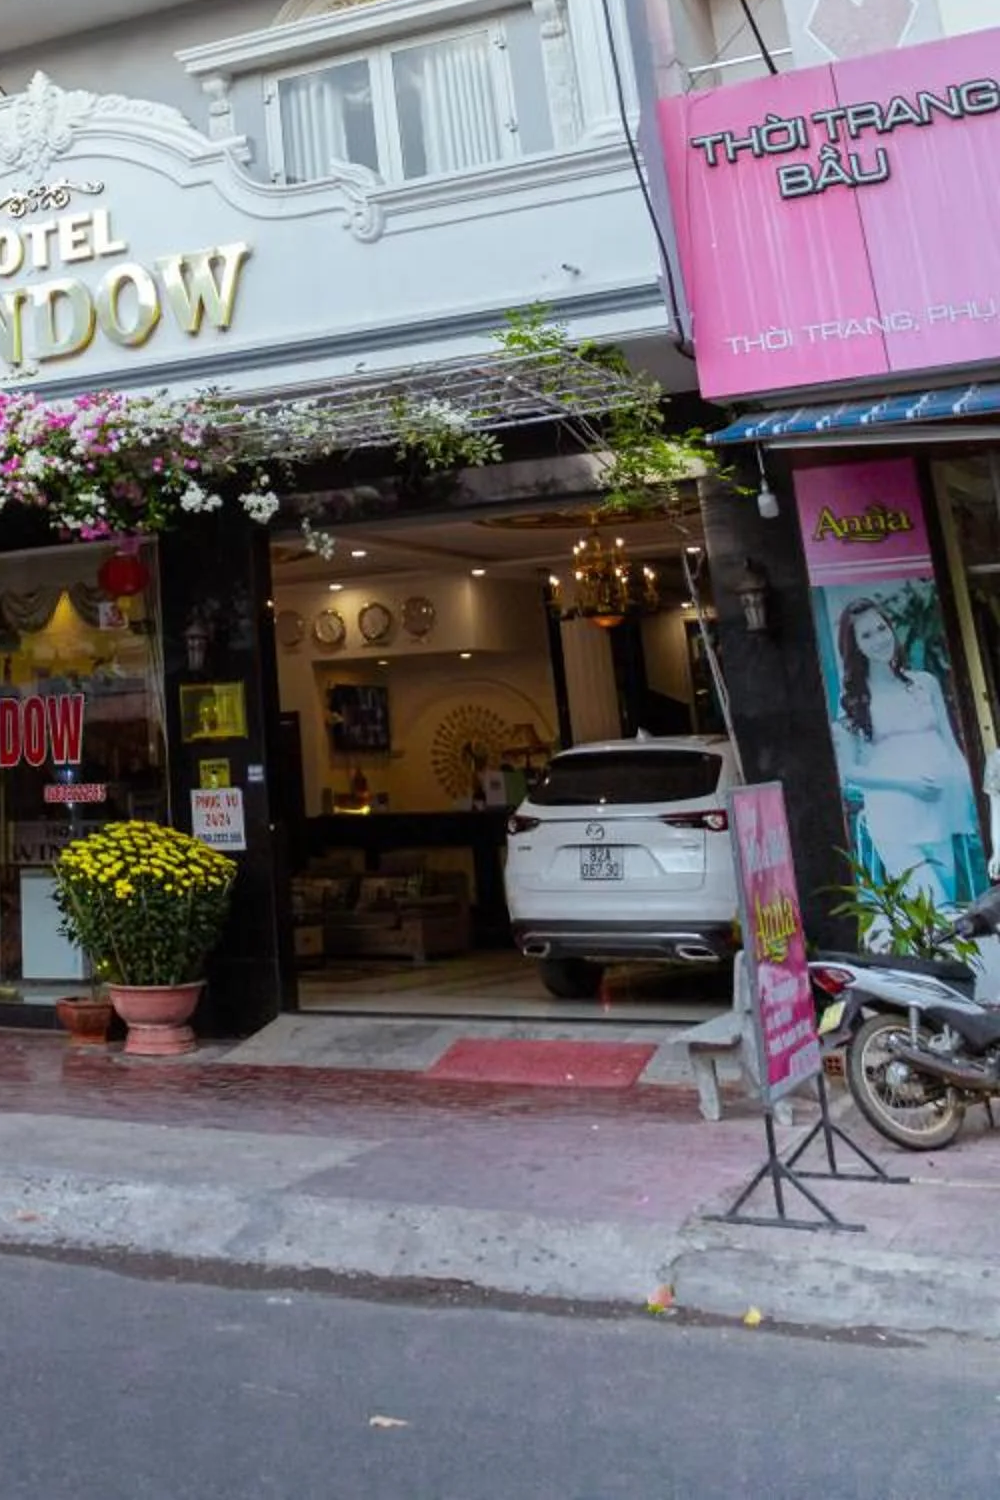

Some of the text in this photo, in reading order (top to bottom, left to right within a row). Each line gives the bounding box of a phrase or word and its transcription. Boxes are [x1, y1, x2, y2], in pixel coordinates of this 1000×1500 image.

[691, 77, 1000, 168] THỜI TRANG
[776, 143, 892, 200] BẦU
[725, 325, 793, 356] THỜI
[800, 310, 921, 344] TRANG,
